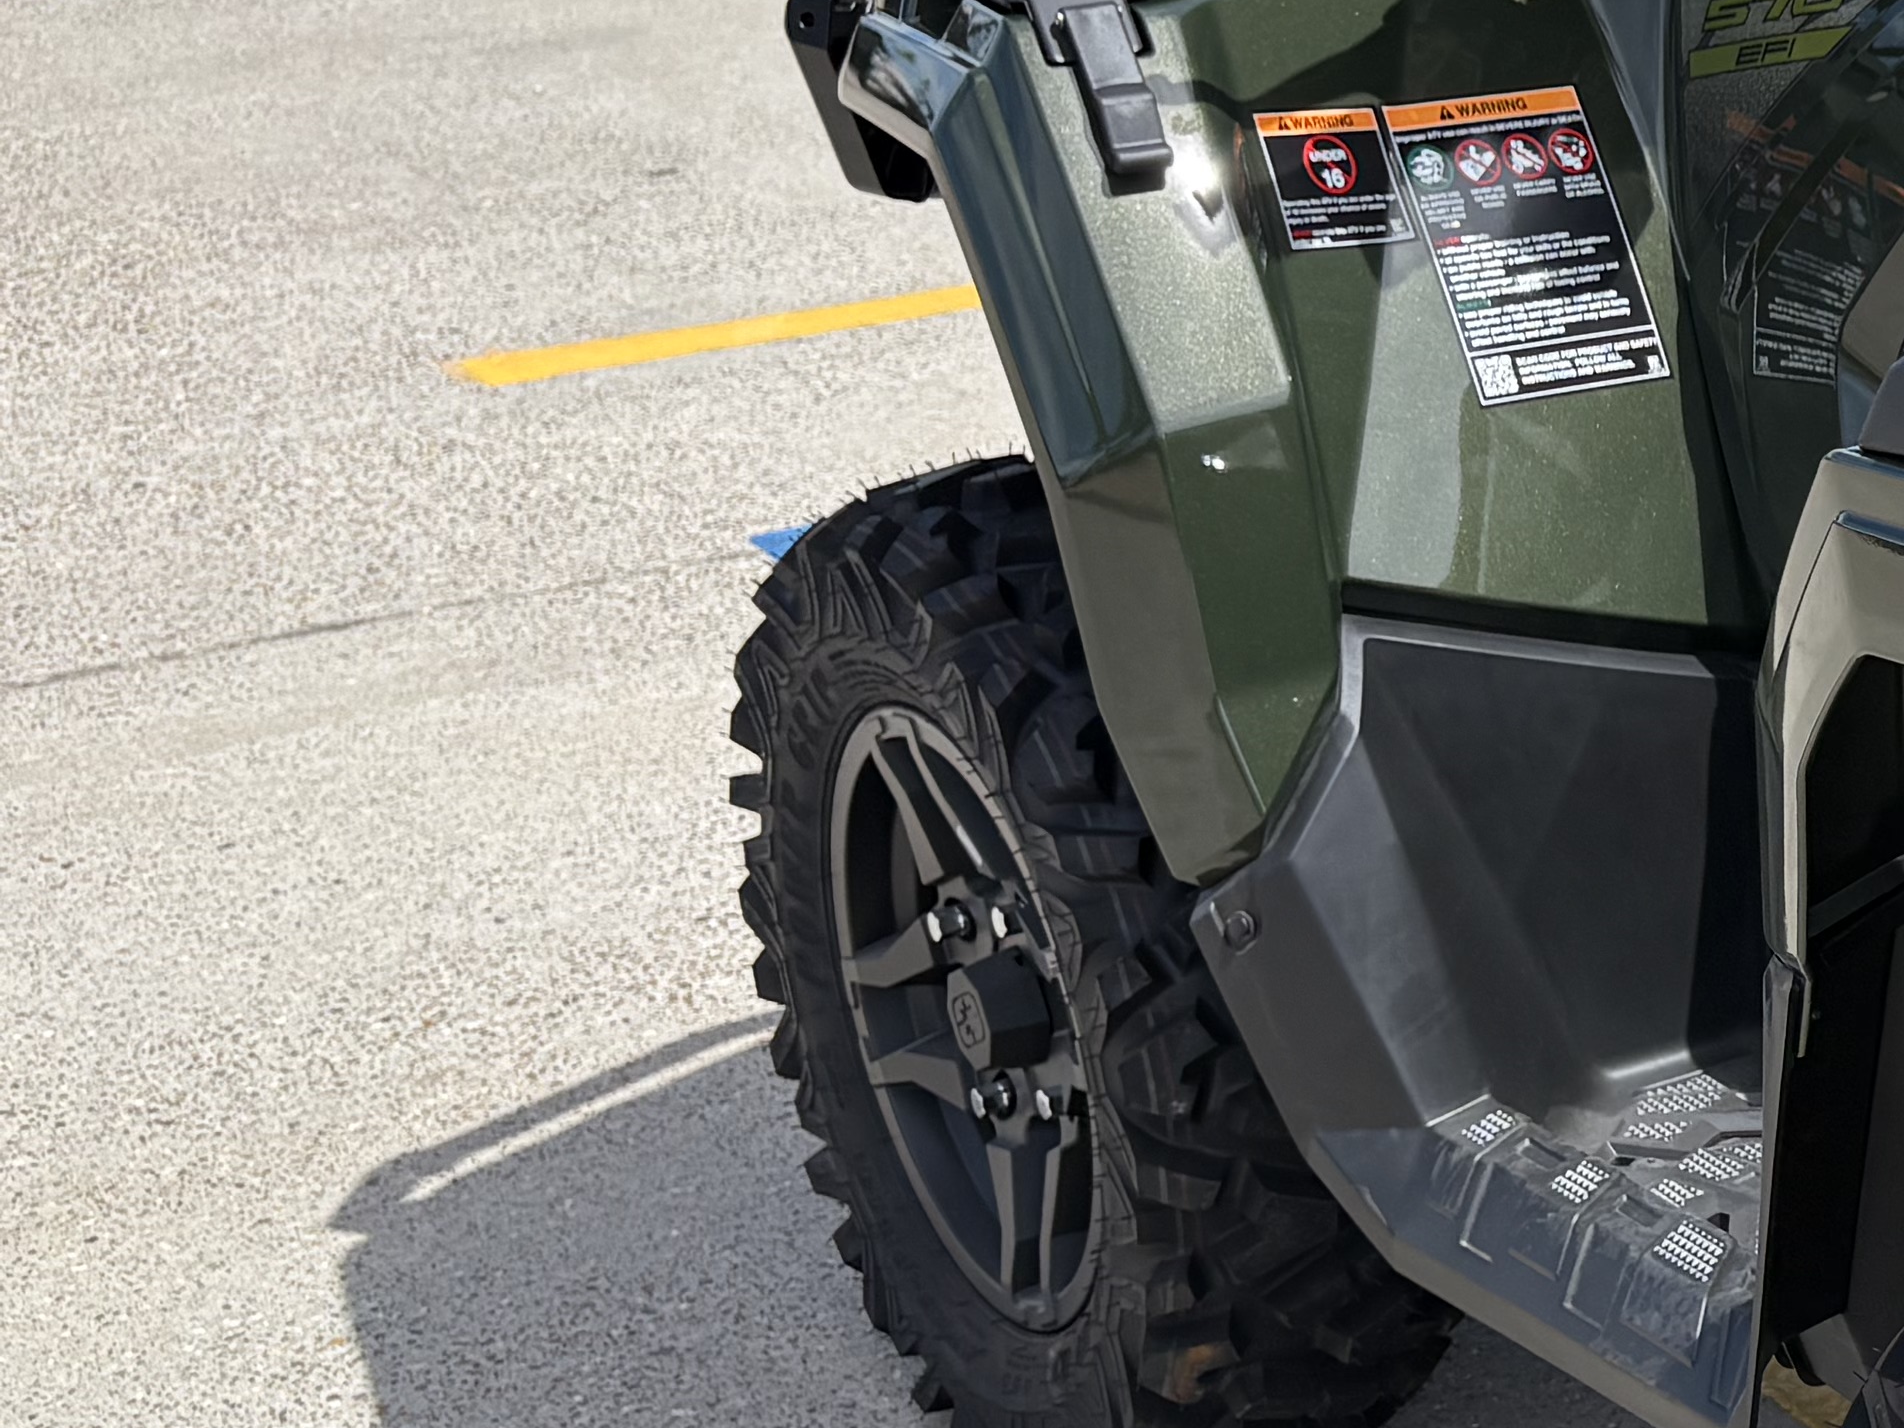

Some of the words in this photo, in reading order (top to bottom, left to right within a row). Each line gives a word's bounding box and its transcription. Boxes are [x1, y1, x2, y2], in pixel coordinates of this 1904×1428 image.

[1735, 37, 1797, 66] EFI
[1455, 97, 1527, 117] WARNING
[1291, 114, 1354, 130] WARNING
[1308, 148, 1347, 163] UNDER
[1320, 167, 1346, 189] 16
